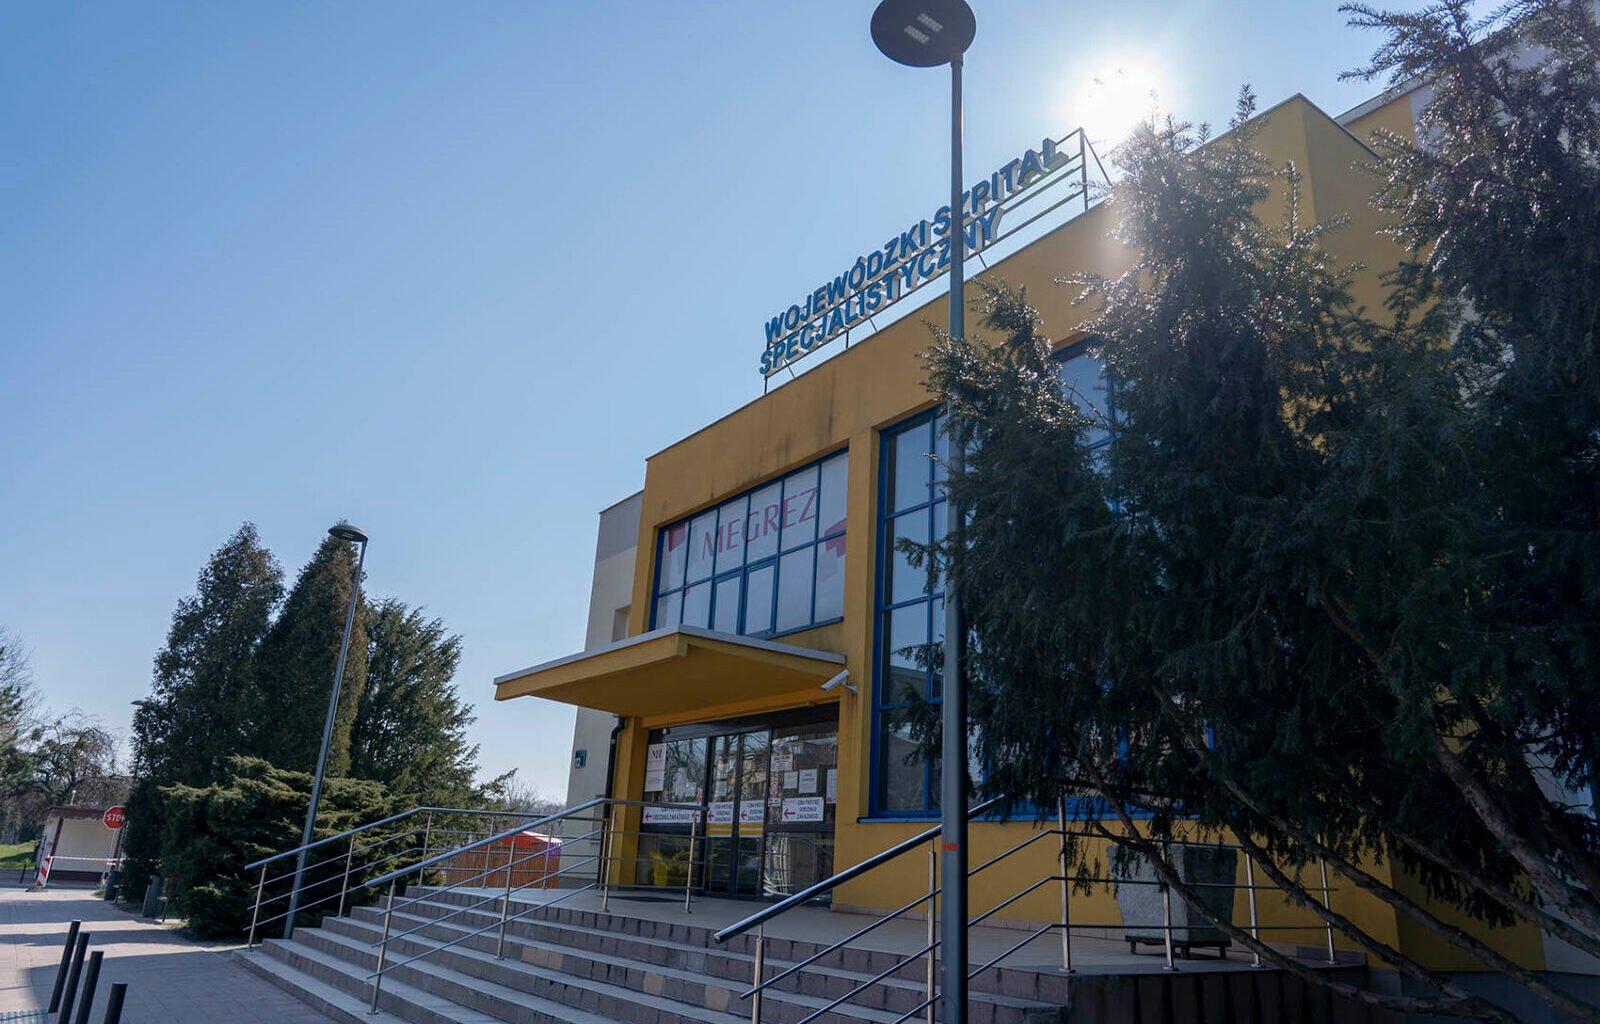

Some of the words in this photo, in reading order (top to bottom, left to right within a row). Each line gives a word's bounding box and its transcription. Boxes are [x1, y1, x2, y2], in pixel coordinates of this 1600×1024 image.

[759, 206, 1004, 375] SPECJALISTYCZNY
[764, 218, 932, 342] WOJEWÓDZKI
[933, 137, 1068, 236] SZPITAL
[703, 487, 818, 560] MEGREZ
